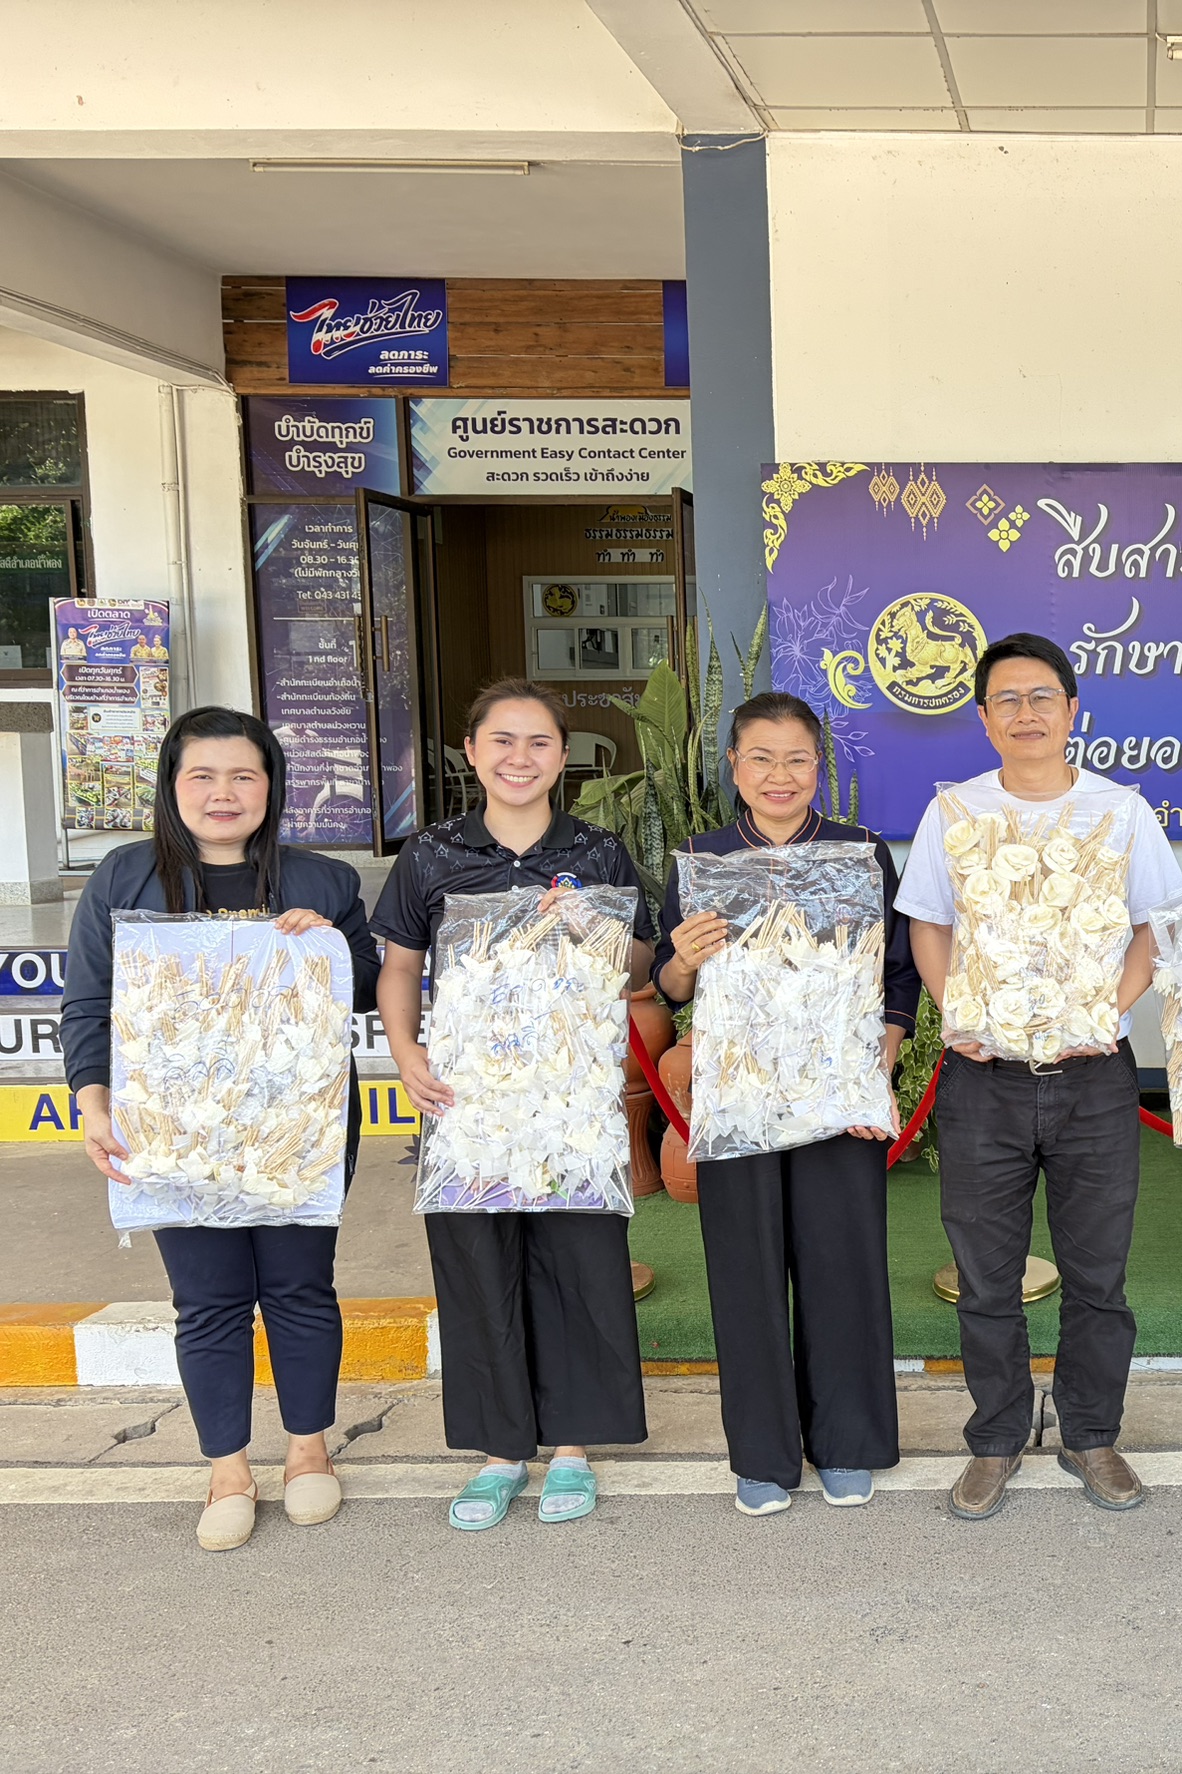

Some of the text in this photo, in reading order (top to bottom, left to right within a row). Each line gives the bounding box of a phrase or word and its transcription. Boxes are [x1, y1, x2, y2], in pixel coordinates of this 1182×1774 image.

[379, 350, 429, 360] ลดภาระ
[368, 363, 438, 374] ลดค่าครองชีพ
[275, 415, 374, 448] บำบัดทุกข์
[451, 411, 681, 442] ศูนย์ราชการสะดวก
[447, 447, 687, 461] Government Easy Contact Center
[285, 445, 365, 478] บำรุงสุข
[486, 468, 650, 482] สะดวก รวดเร็ว เข้าถึงง่าย
[305, 523, 353, 533] เวลาทำการ
[291, 539, 328, 549] วันจันทร์
[0, 554, 62, 569] สดีอำเภอน้ำพอง
[300, 555, 327, 564] 08.30
[596, 549, 664, 562] ทำ ทำ ทำ
[315, 590, 332, 599] 043
[335, 590, 350, 599] 431
[88, 609, 131, 619] เปิดตลาด
[892, 685, 965, 707] กรมการปกครอง
